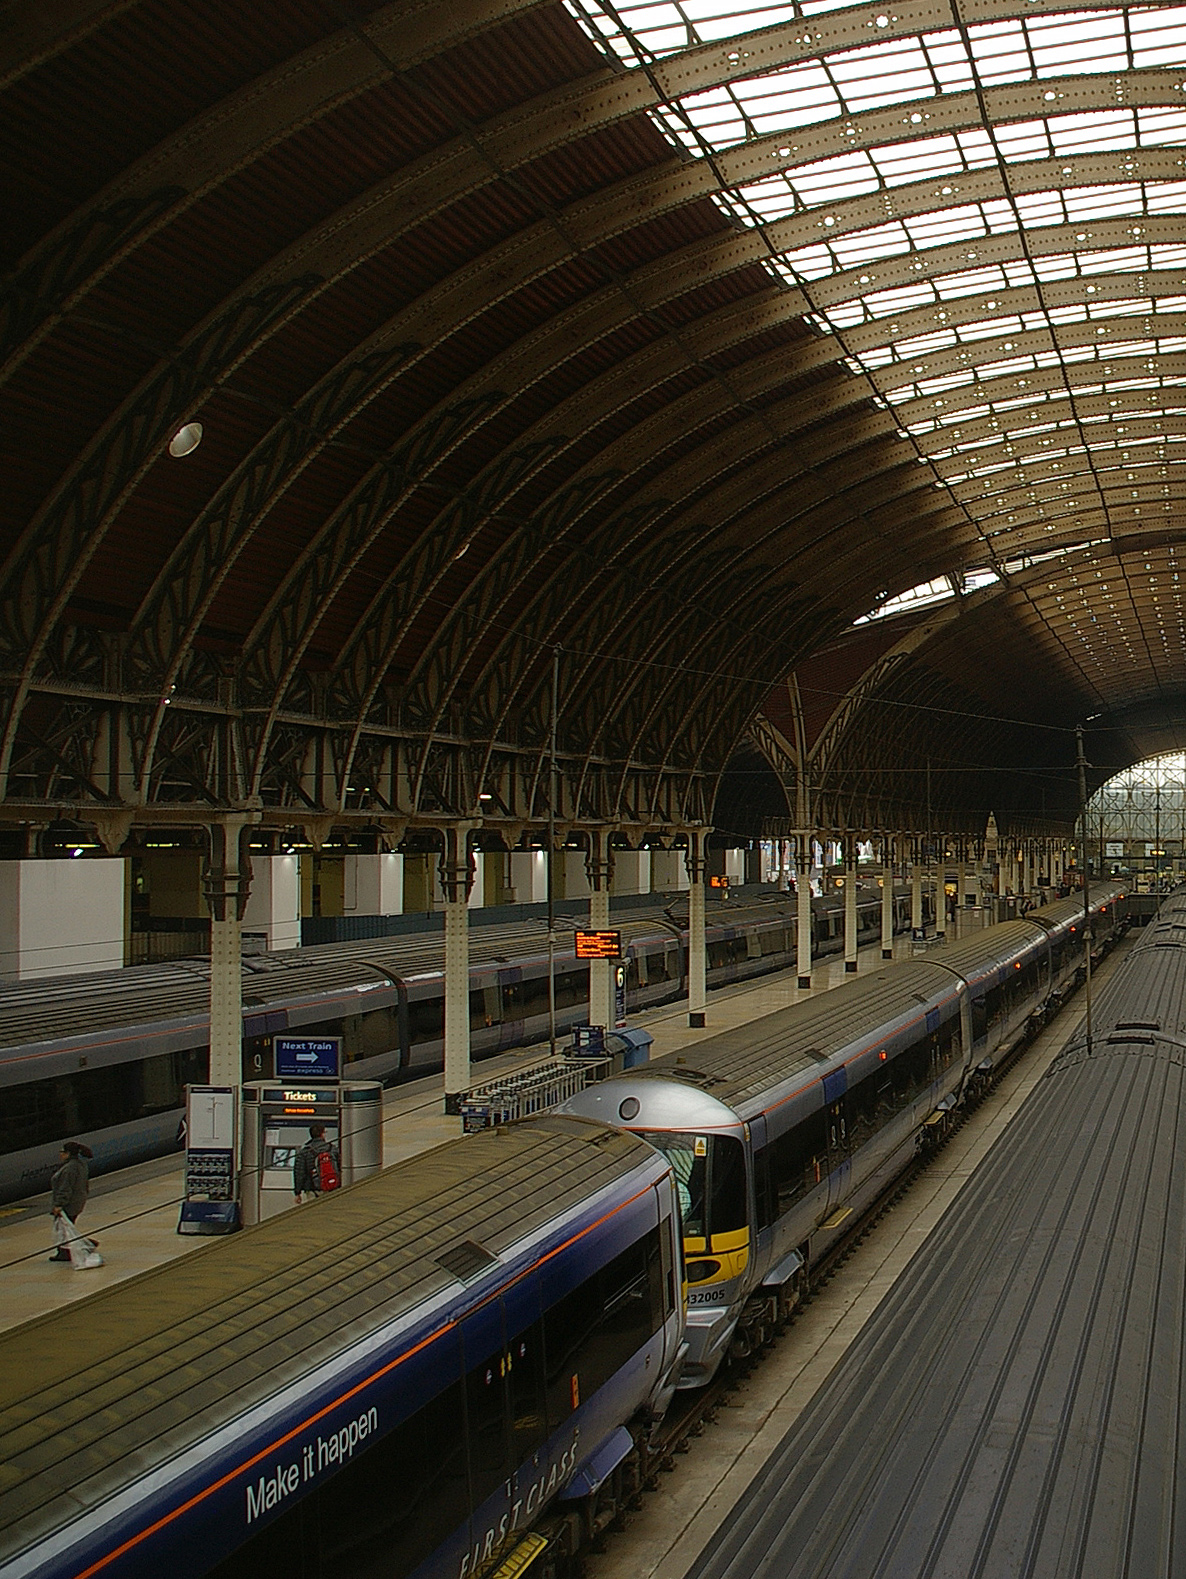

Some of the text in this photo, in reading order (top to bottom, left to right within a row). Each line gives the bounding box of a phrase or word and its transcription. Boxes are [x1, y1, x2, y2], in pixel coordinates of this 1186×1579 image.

[616, 967, 624, 988] 6
[282, 1042, 332, 1050] Next Train
[283, 1091, 317, 1101] Tickets
[246, 1406, 378, 1524] Make it happen
[460, 1442, 578, 1579] FIRST CLASS
